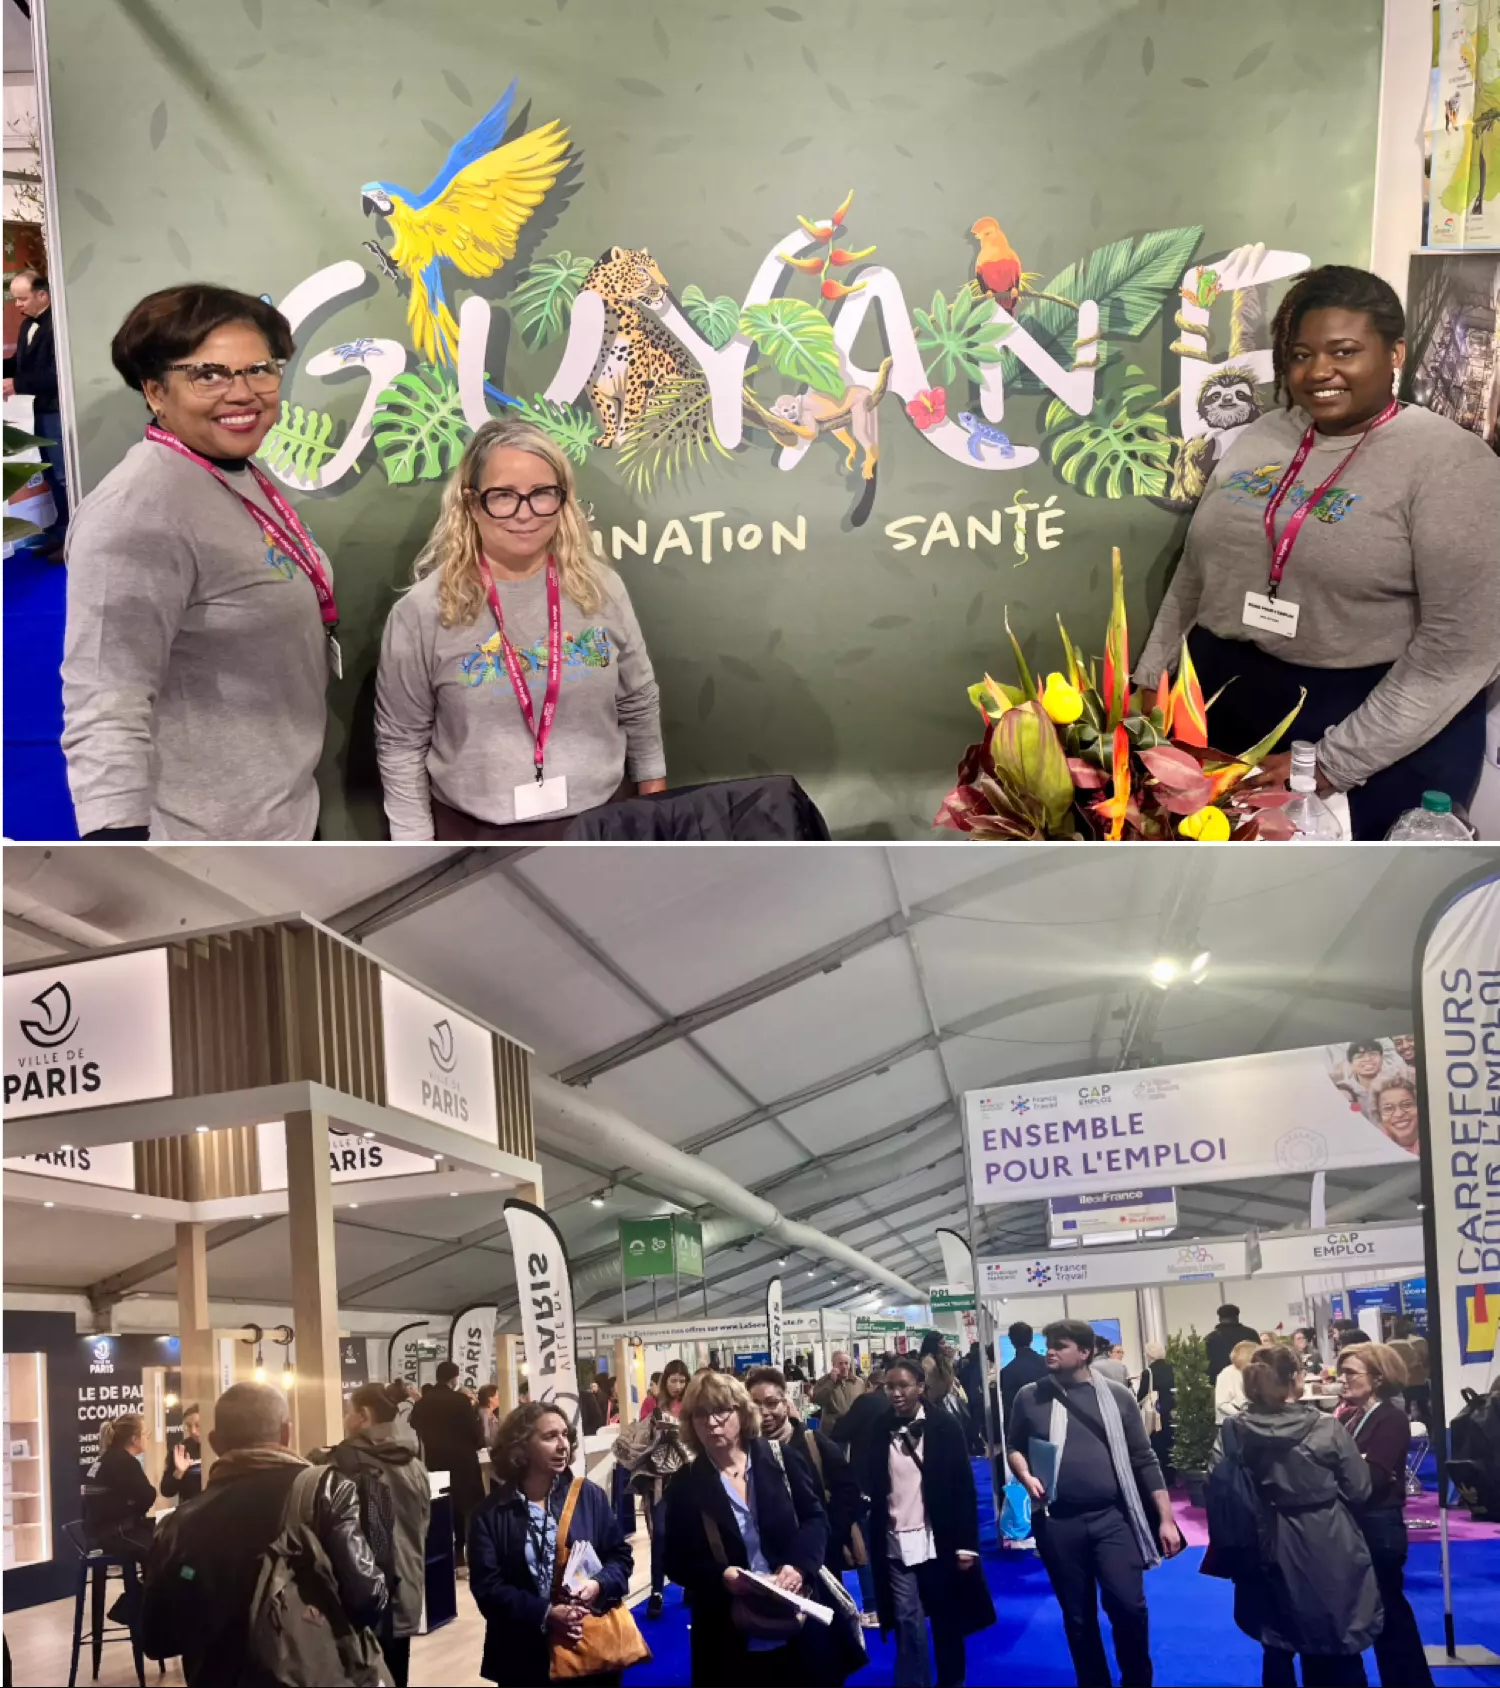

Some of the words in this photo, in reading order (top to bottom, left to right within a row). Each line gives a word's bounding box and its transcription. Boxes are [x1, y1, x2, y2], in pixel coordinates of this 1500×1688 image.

[885, 495, 1067, 557] SANTÉ
[18, 1052, 59, 1068] VILLE
[67, 1048, 85, 1060] DE
[3, 1062, 101, 1104] PARIS
[1079, 1084, 1111, 1098] CAP
[421, 1080, 469, 1122] PARIS
[1441, 967, 1482, 1275] CARREFOURS
[983, 1113, 1144, 1151] ENSEMBLE
[986, 1155, 1073, 1184] POUR
[1082, 1138, 1227, 1175] L'EMPLOI
[1327, 1232, 1359, 1245] CAP
[1313, 1242, 1375, 1258] EMPLOI
[1055, 1264, 1087, 1273] France
[1056, 1271, 1087, 1281] Travail
[464, 1327, 482, 1390] PARIS
[90, 1364, 114, 1374] PARIS
[99, 1386, 119, 1401] DE
